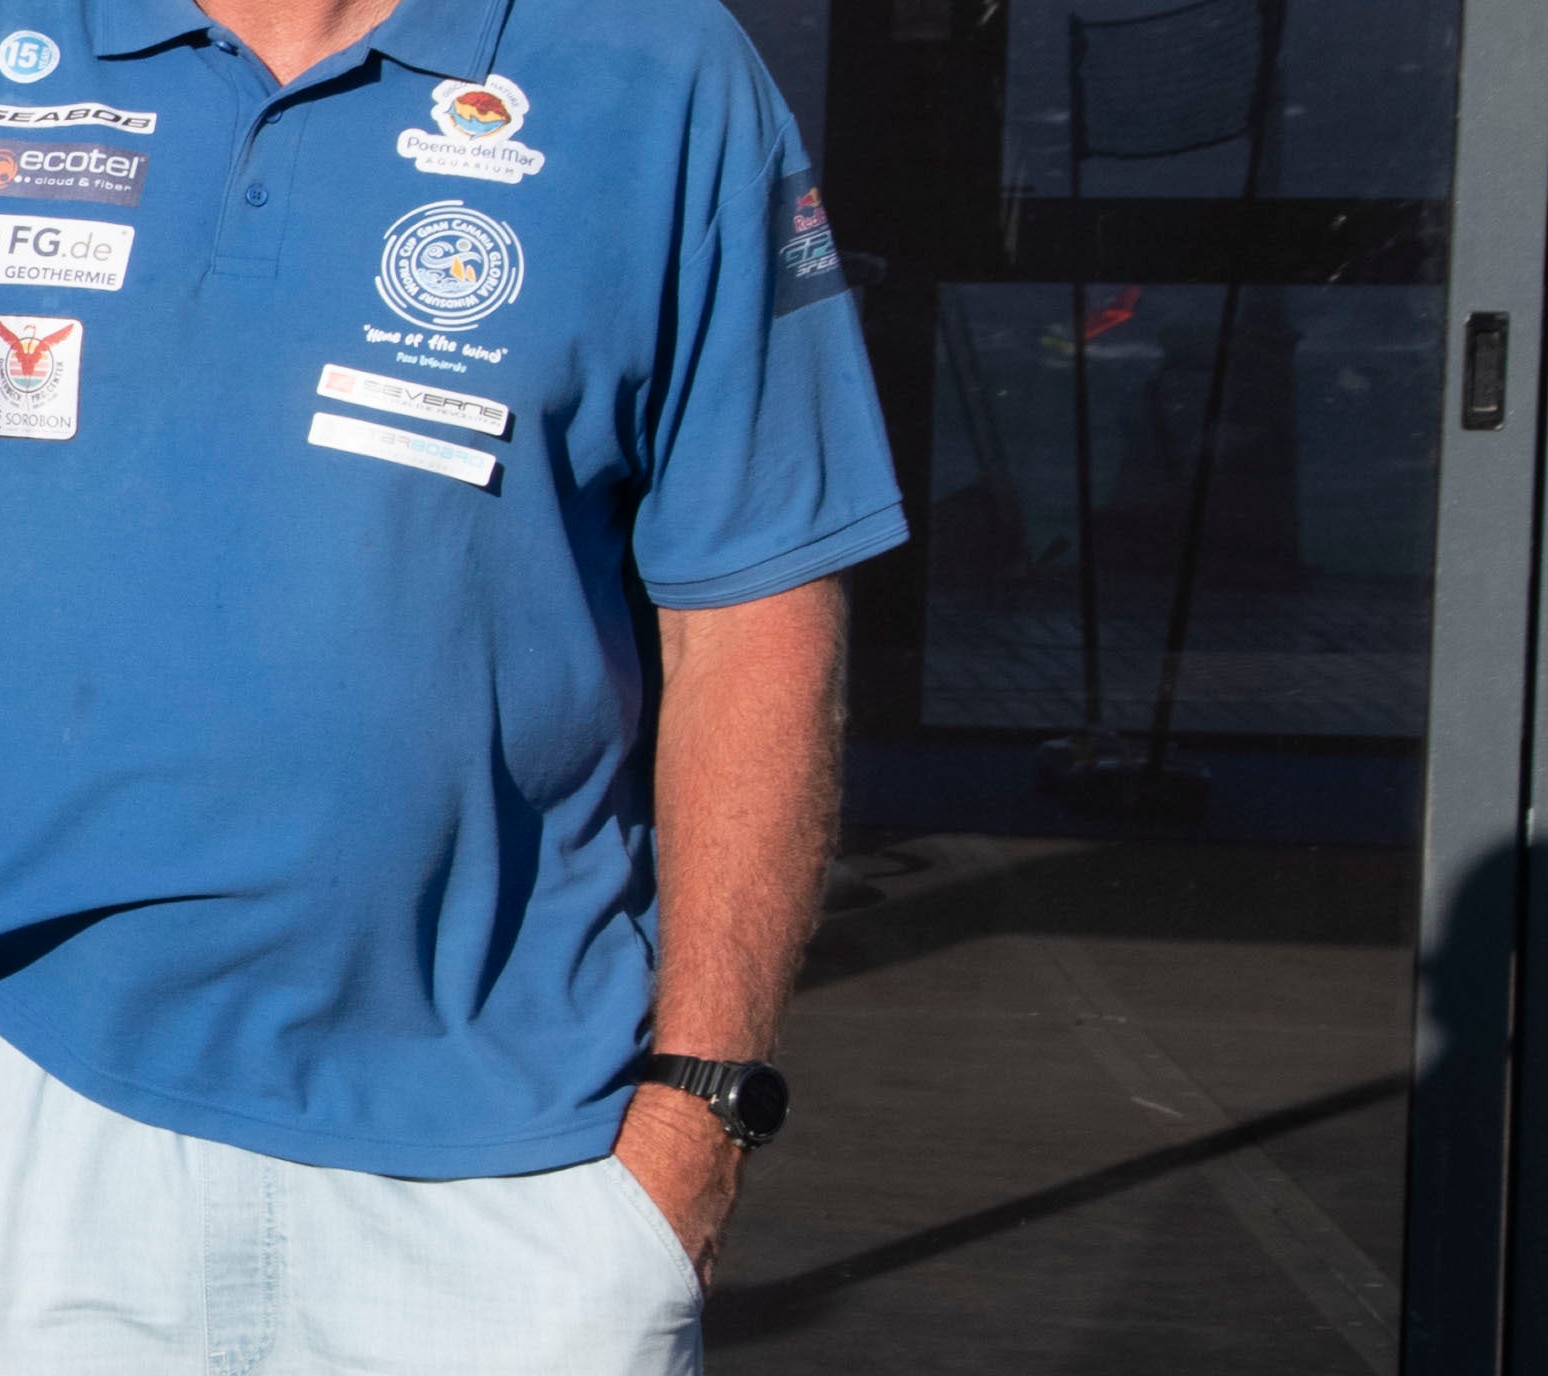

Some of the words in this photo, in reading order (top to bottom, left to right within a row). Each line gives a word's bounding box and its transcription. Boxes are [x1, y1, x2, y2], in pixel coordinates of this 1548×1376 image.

[7, 41, 39, 68] 15
[20, 149, 139, 179] ecotel
[407, 136, 466, 156] Poema
[471, 145, 497, 159] del
[501, 149, 535, 167] Mar
[425, 157, 515, 175] AQUARIUM
[34, 176, 74, 187] cloud
[78, 177, 90, 187] &
[94, 178, 132, 192] fiber
[416, 220, 449, 238] GRAN
[8, 225, 113, 261] FG.de
[399, 237, 418, 257] CUP
[4, 265, 118, 286] GEOTHERMIE
[398, 259, 420, 297] WORLD
[476, 251, 502, 298] GLORIA
[363, 379, 504, 421] SEVERNE
[6, 412, 72, 428] SOROBON
